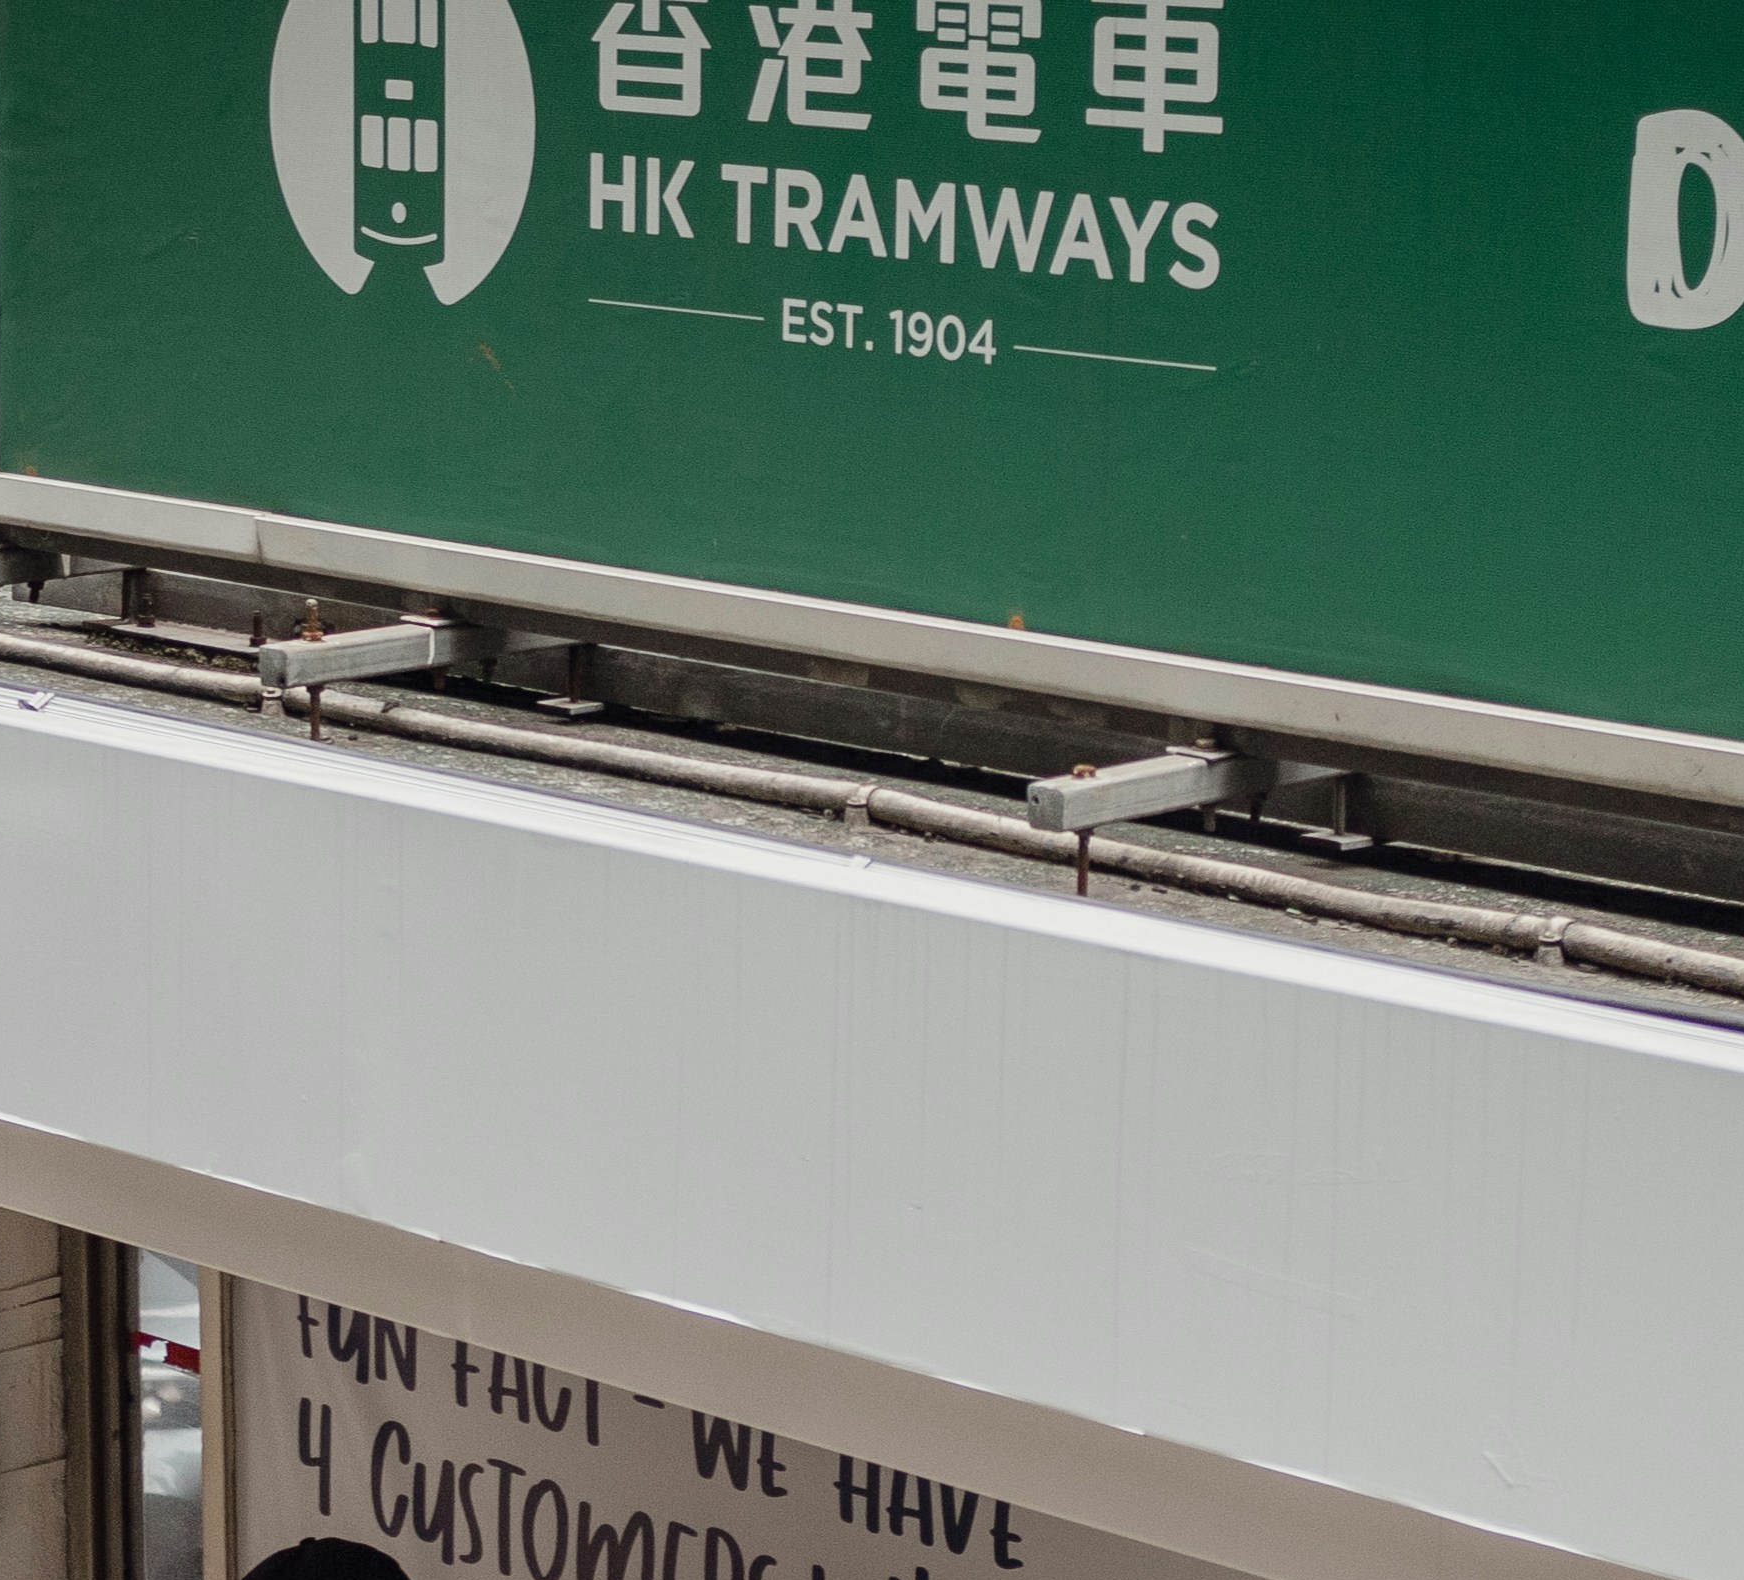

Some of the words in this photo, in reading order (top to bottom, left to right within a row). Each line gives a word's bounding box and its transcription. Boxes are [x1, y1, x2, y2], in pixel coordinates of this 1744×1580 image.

[590, 152, 695, 238] HK
[721, 162, 1220, 290] TRAMWAYS
[782, 298, 874, 351] EST.
[889, 309, 996, 364] 1904
[298, 1397, 331, 1517] 4
